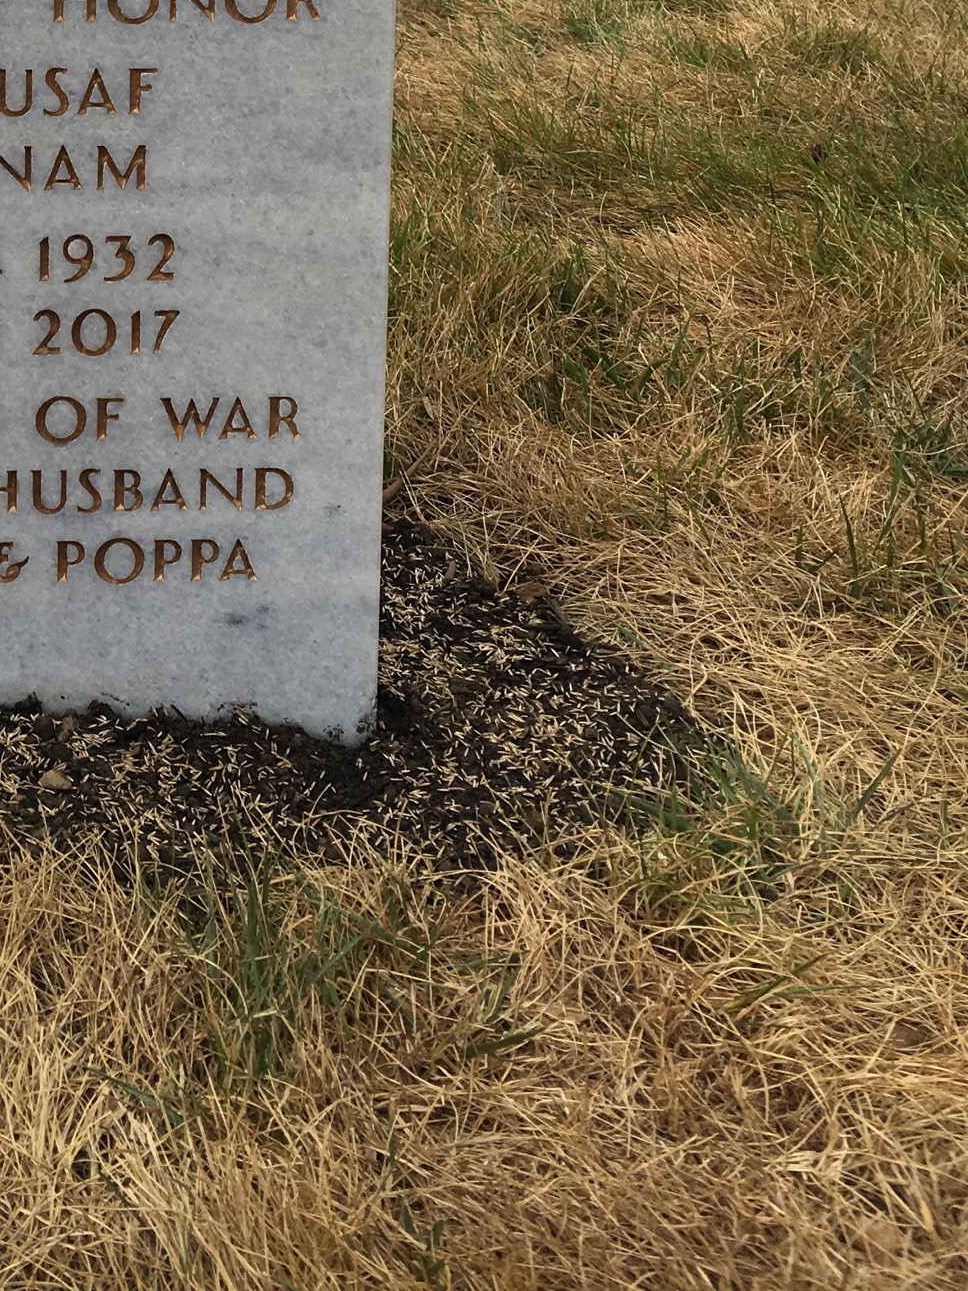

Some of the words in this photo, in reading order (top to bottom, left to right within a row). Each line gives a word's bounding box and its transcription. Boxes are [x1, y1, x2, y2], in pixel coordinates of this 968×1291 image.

[37, 233, 177, 283] 1932
[32, 308, 182, 356] 2017
[34, 395, 126, 445] OF
[159, 395, 303, 442] WAR
[54, 537, 258, 585] POPPA
